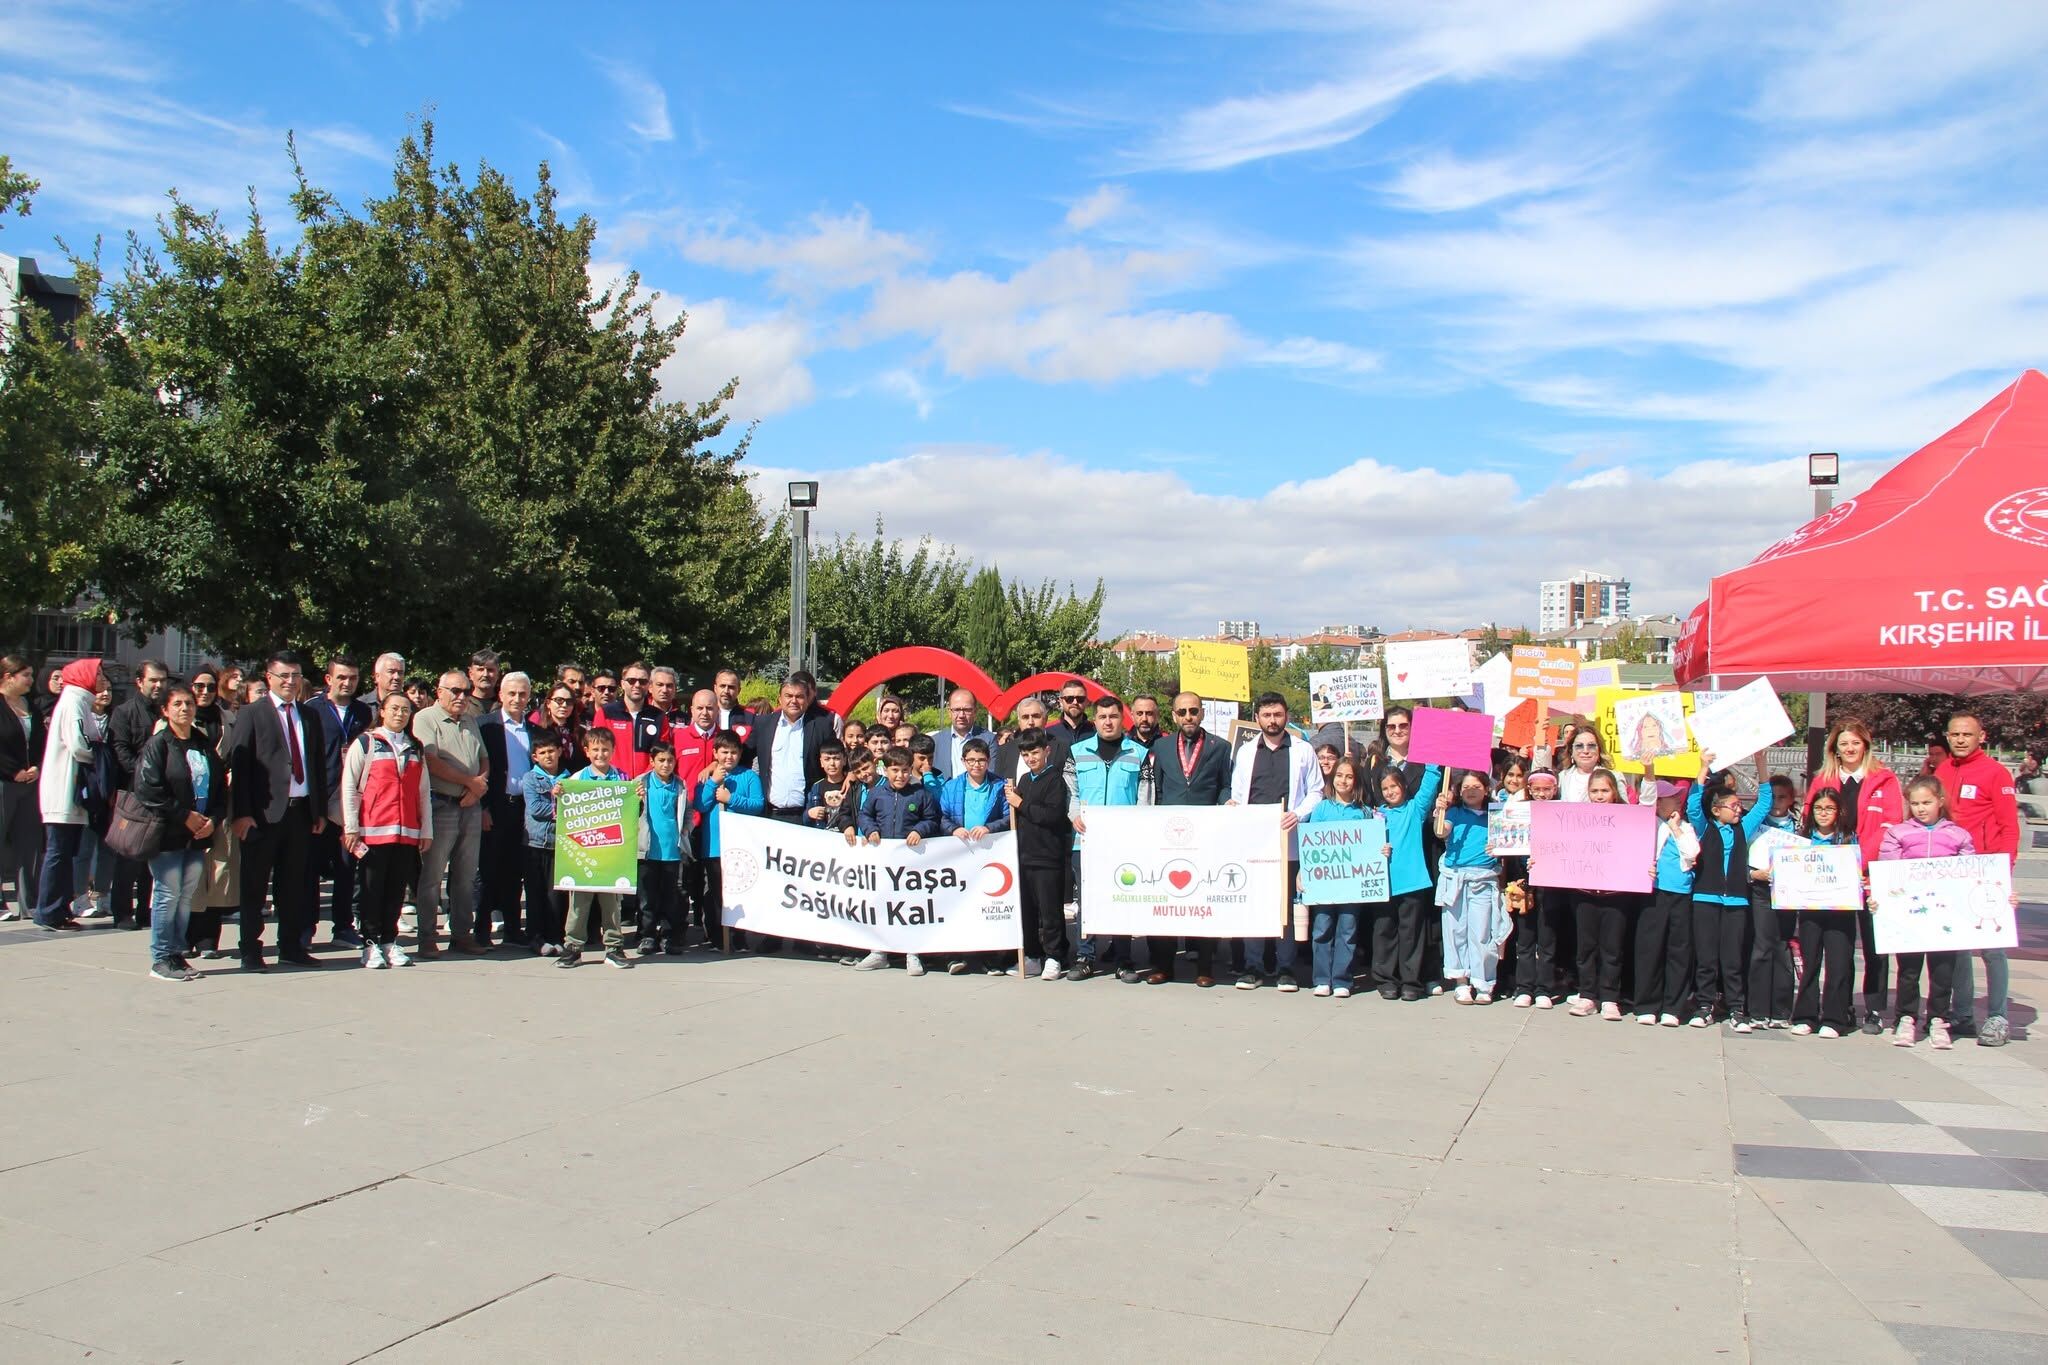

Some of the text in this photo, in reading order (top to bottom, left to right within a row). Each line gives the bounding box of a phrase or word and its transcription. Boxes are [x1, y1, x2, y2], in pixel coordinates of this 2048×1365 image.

[1914, 589, 1974, 612] T.C.
[1880, 615, 2048, 648] KIRŞEHİR İL
[561, 787, 613, 806] Obezite
[563, 797, 624, 818] mücadele
[565, 808, 622, 829] ediyoruz!
[580, 835, 595, 846] 30
[1803, 850, 1824, 863] GÜN
[765, 846, 967, 894] Hareketli Yaşa,
[1304, 861, 1385, 882] YORULMAZ
[780, 884, 945, 926] Sağlıklı Kal.
[1143, 895, 1169, 903] BESLEN
[1206, 895, 1247, 903] HAREKET ET
[981, 905, 1014, 914] KIZILAY
[1153, 906, 1213, 920] MUTLU YAŞA
